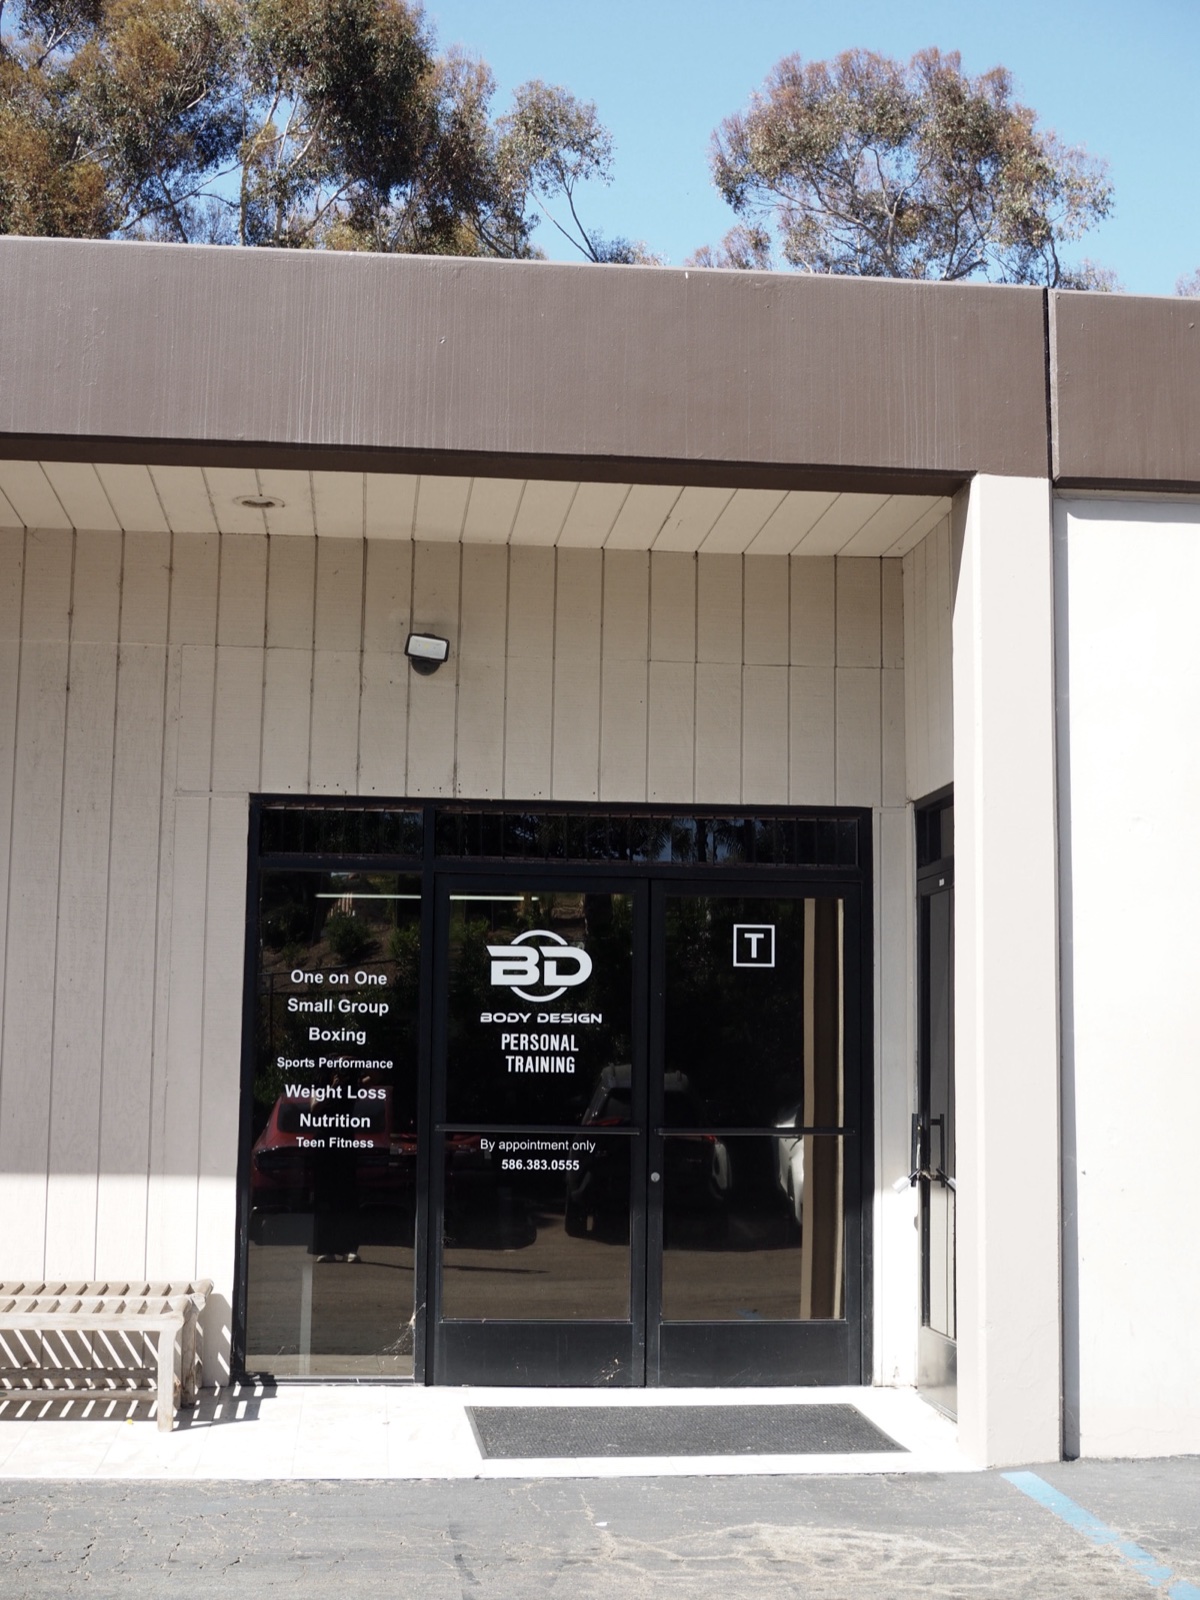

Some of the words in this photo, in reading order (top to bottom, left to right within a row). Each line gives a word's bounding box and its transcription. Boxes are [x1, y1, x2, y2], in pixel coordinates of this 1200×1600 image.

[744, 932, 765, 959] T
[486, 944, 593, 987] BD
[290, 969, 324, 984] One
[328, 973, 349, 985] on
[354, 970, 388, 985] One
[287, 997, 333, 1013] Small
[338, 998, 389, 1017] Group
[480, 1012, 532, 1023] BODY
[536, 1012, 603, 1024] DESIGN
[308, 1027, 367, 1045] Boxing
[501, 1033, 579, 1052] PERSONAL
[276, 1056, 315, 1070] Sports
[318, 1057, 394, 1069] Performance
[505, 1055, 575, 1074] TRAINING
[284, 1084, 342, 1102] Weight
[347, 1085, 387, 1100] Loss
[299, 1113, 371, 1128] Nutrition
[296, 1136, 325, 1148] Teen
[329, 1136, 374, 1149] Fitness
[480, 1138, 496, 1153] By
[498, 1139, 569, 1153] appointment
[572, 1140, 596, 1154] only
[501, 1158, 580, 1171] 586.383.0555
